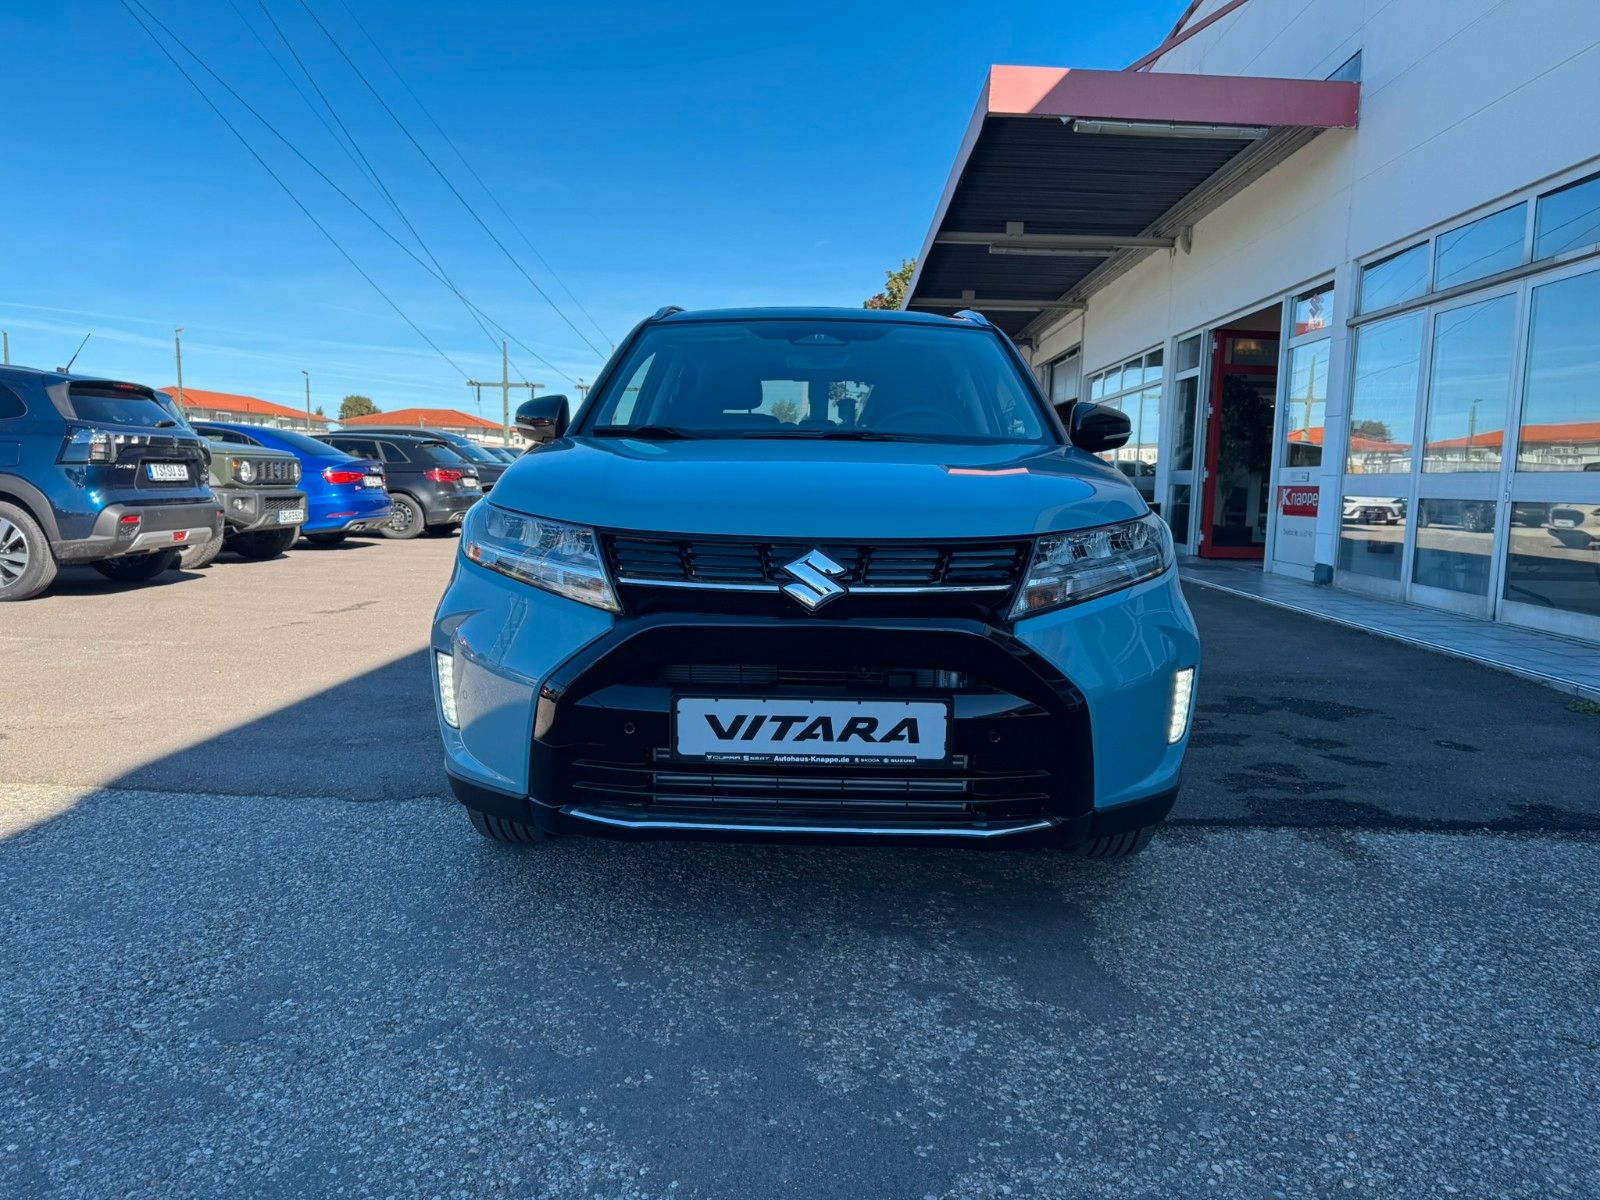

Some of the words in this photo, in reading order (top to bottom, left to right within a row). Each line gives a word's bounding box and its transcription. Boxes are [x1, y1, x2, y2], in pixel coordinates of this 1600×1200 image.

[1282, 488, 1319, 506] Knappe
[703, 714, 920, 744] VITARA
[773, 755, 850, 764] Autohaus-Knappe.de
